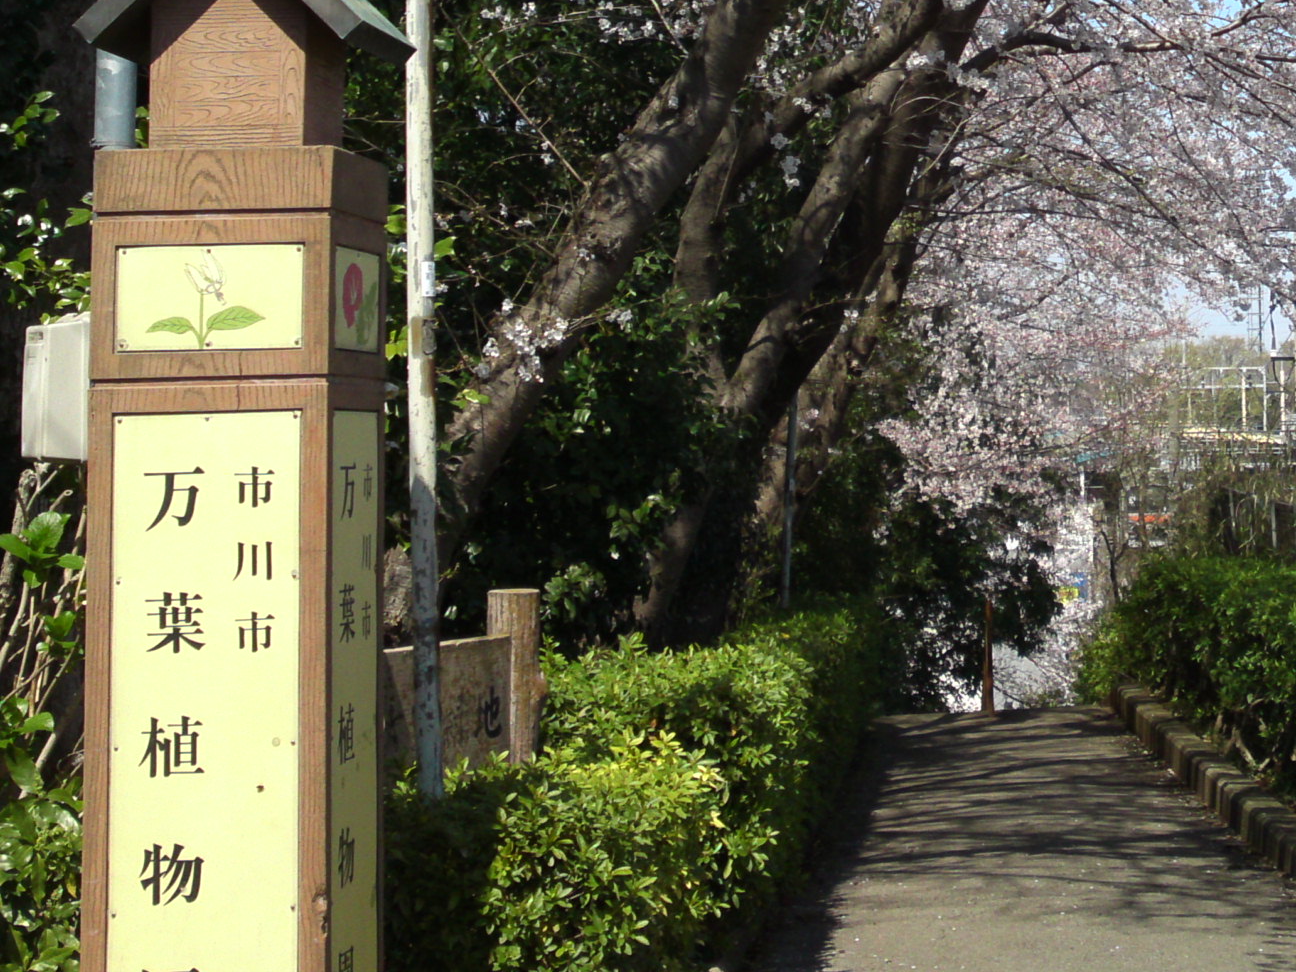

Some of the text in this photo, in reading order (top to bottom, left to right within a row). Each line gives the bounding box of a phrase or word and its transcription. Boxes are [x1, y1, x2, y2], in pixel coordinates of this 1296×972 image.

[233, 465, 276, 653] 市川市
[361, 463, 373, 640] 市川市
[139, 466, 206, 972] 万葉植物
